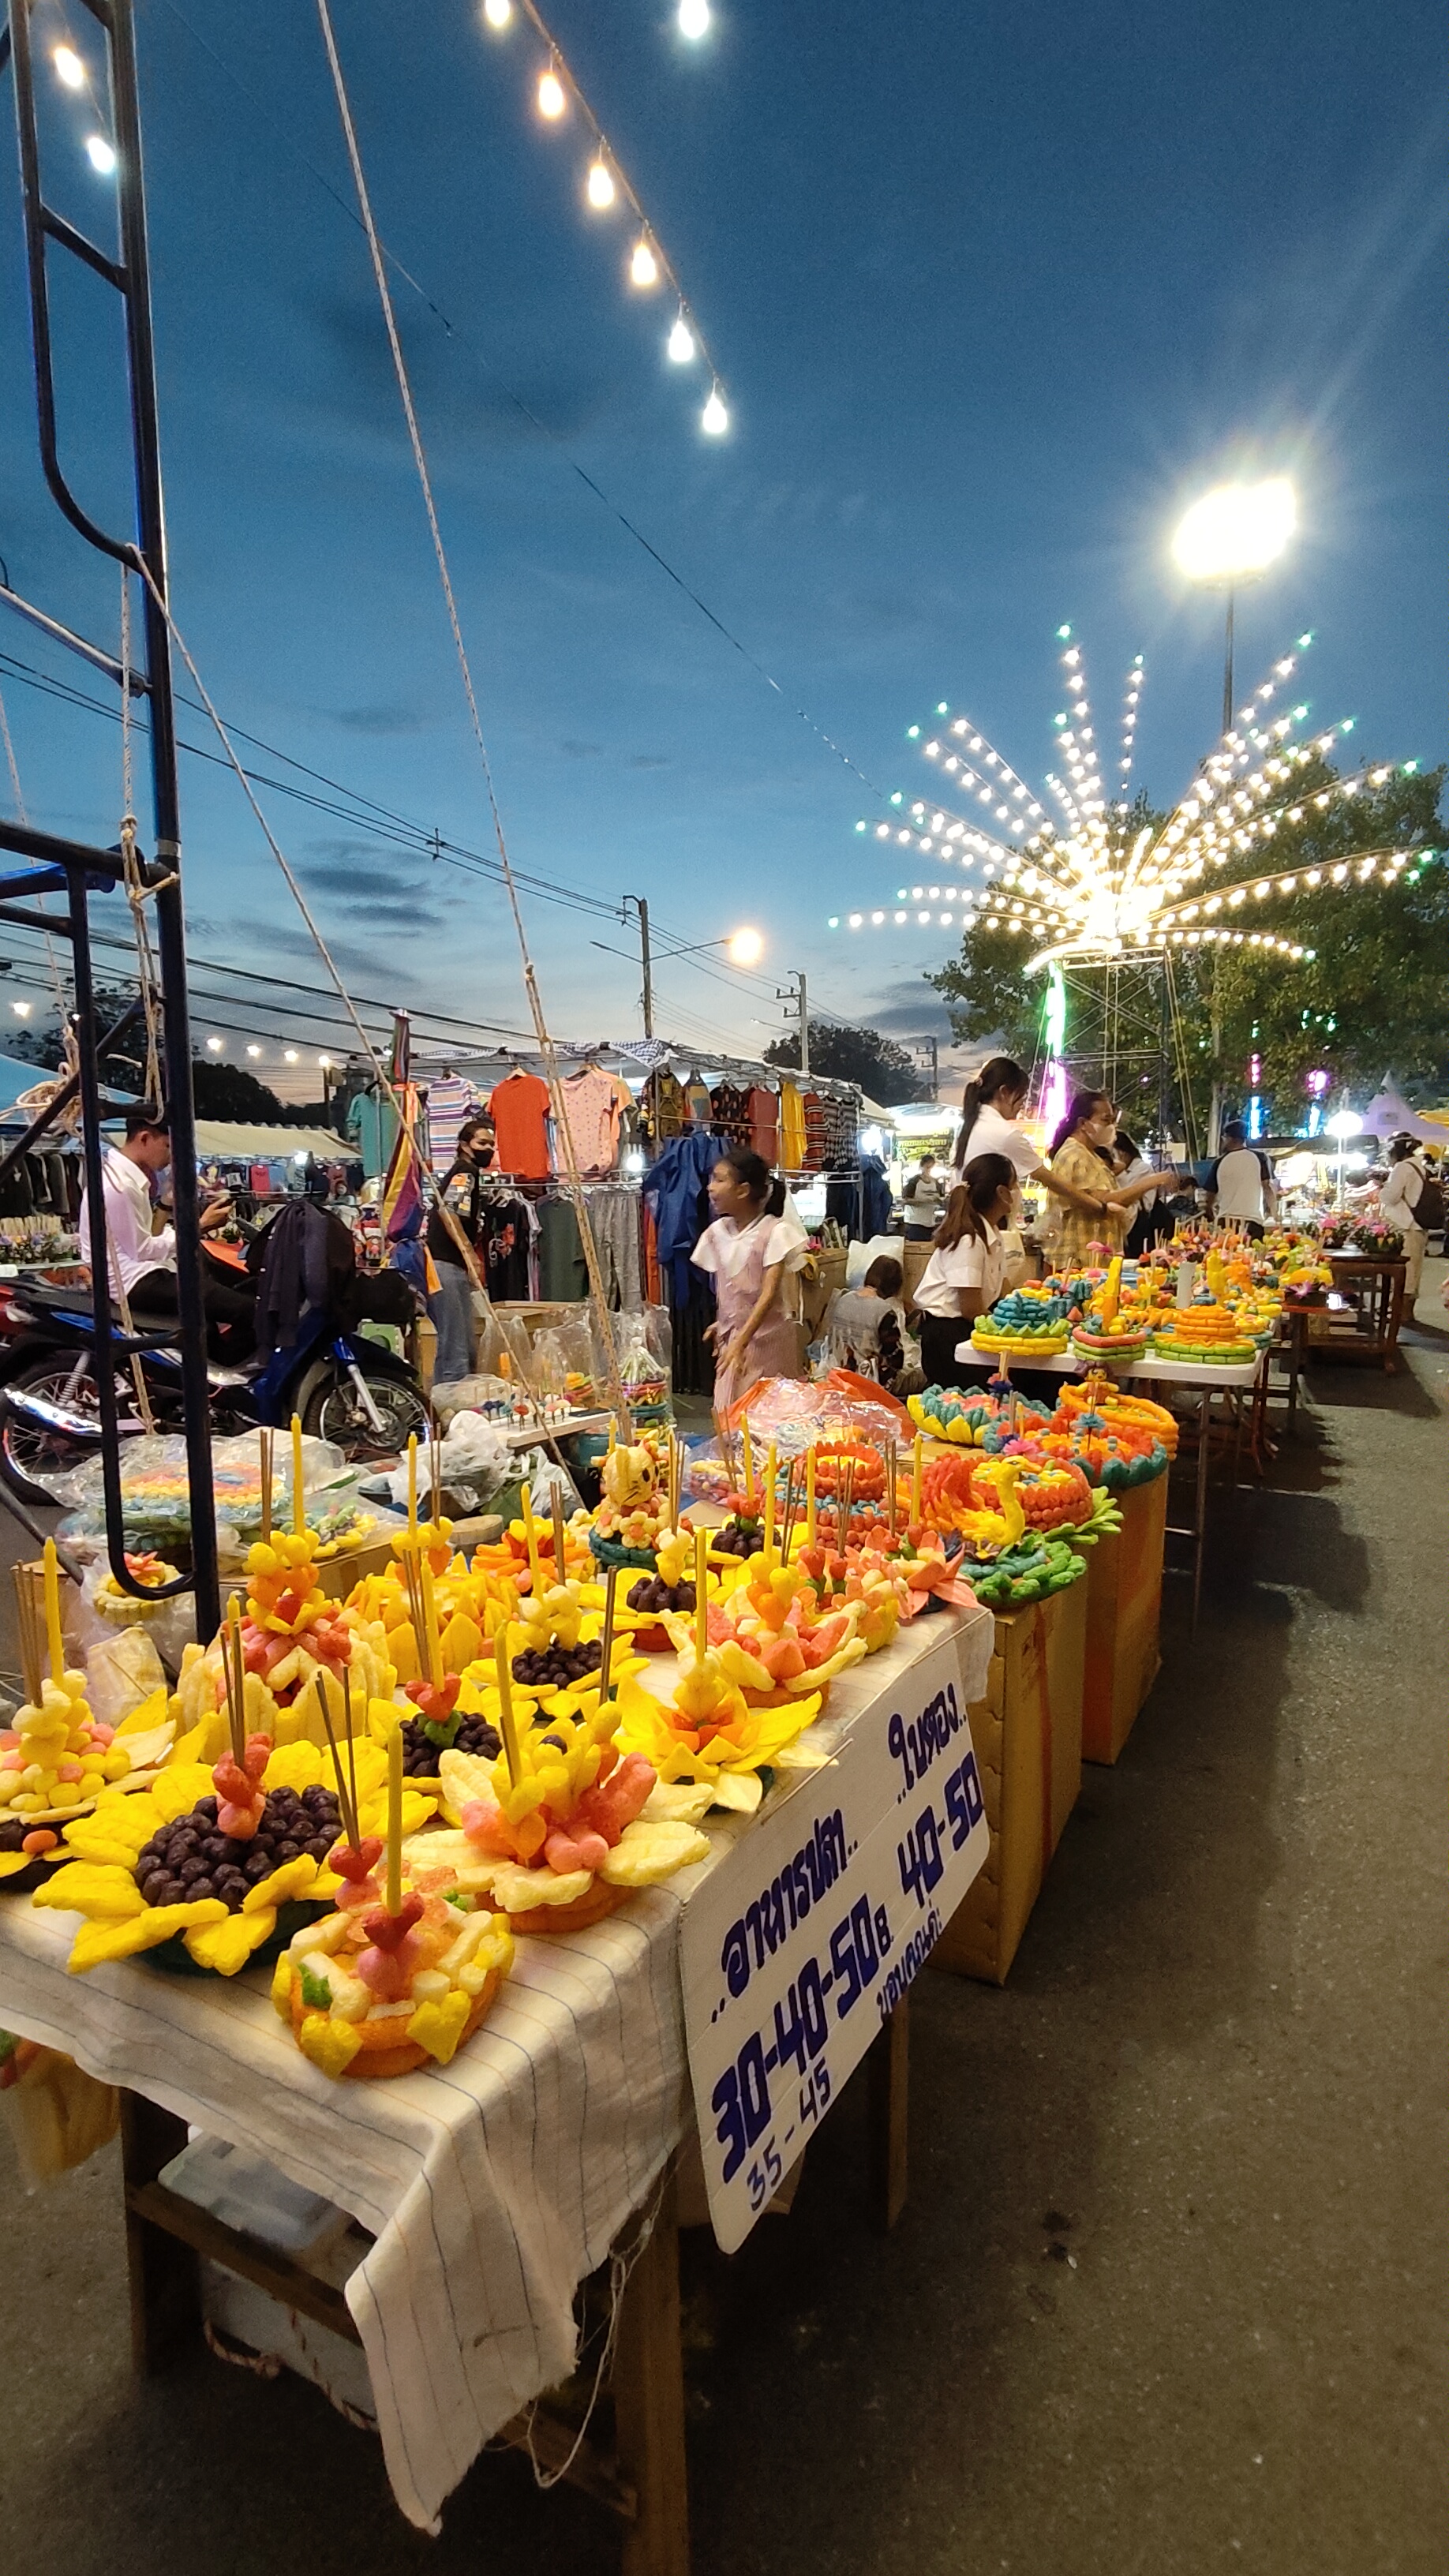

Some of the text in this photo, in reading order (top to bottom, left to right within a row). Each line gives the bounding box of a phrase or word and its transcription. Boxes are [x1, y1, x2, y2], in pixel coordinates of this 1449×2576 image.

[897, 1750, 983, 1910] 40-50
[876, 1898, 943, 2025] ขอบคณค่ะ
